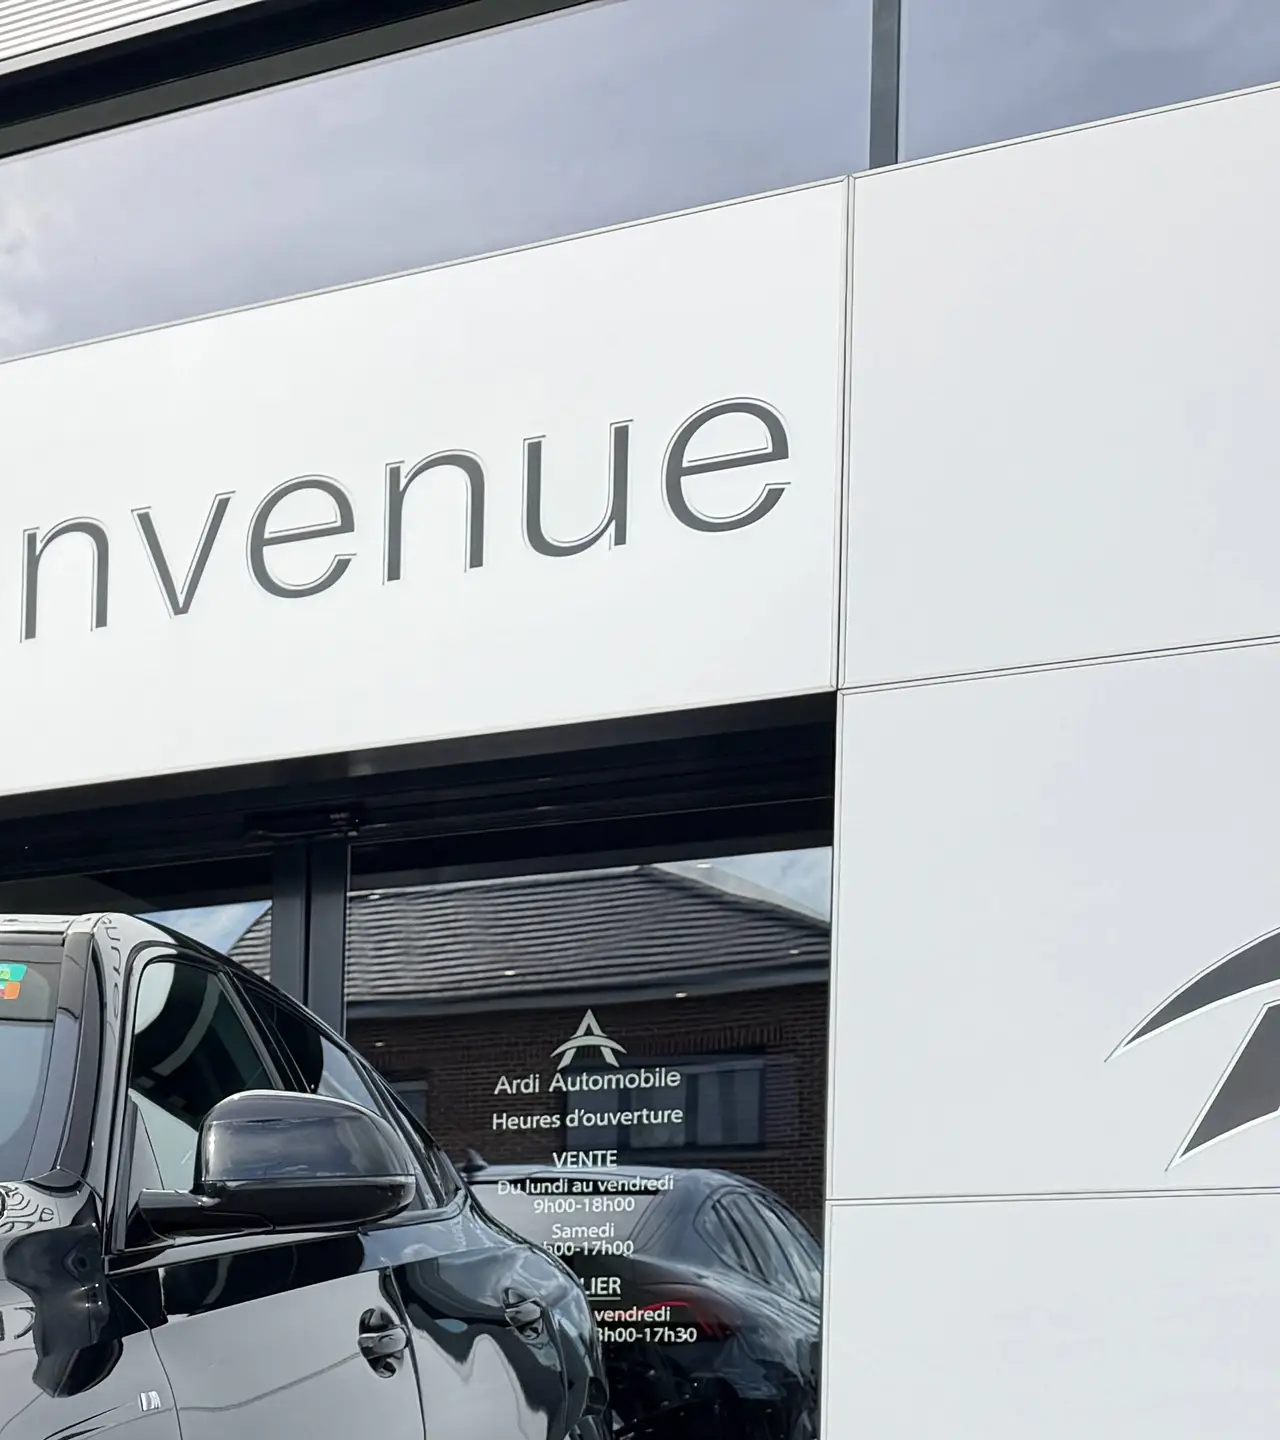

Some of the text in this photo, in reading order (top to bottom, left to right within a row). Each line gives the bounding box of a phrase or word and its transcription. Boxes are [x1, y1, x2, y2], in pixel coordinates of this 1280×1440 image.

[494, 1068, 681, 1095] Ardi Automobile
[492, 1112, 560, 1130] Heures
[552, 1150, 617, 1169] VENTE
[498, 1175, 673, 1195] Du lundi au vendredi
[534, 1197, 634, 1213] 9h00-18h00
[552, 1223, 614, 1238] Samedi
[544, 1240, 633, 1256] h00-17h00
[594, 1306, 671, 1322] vendredi
[596, 1327, 697, 1343] 3h00-17h30
